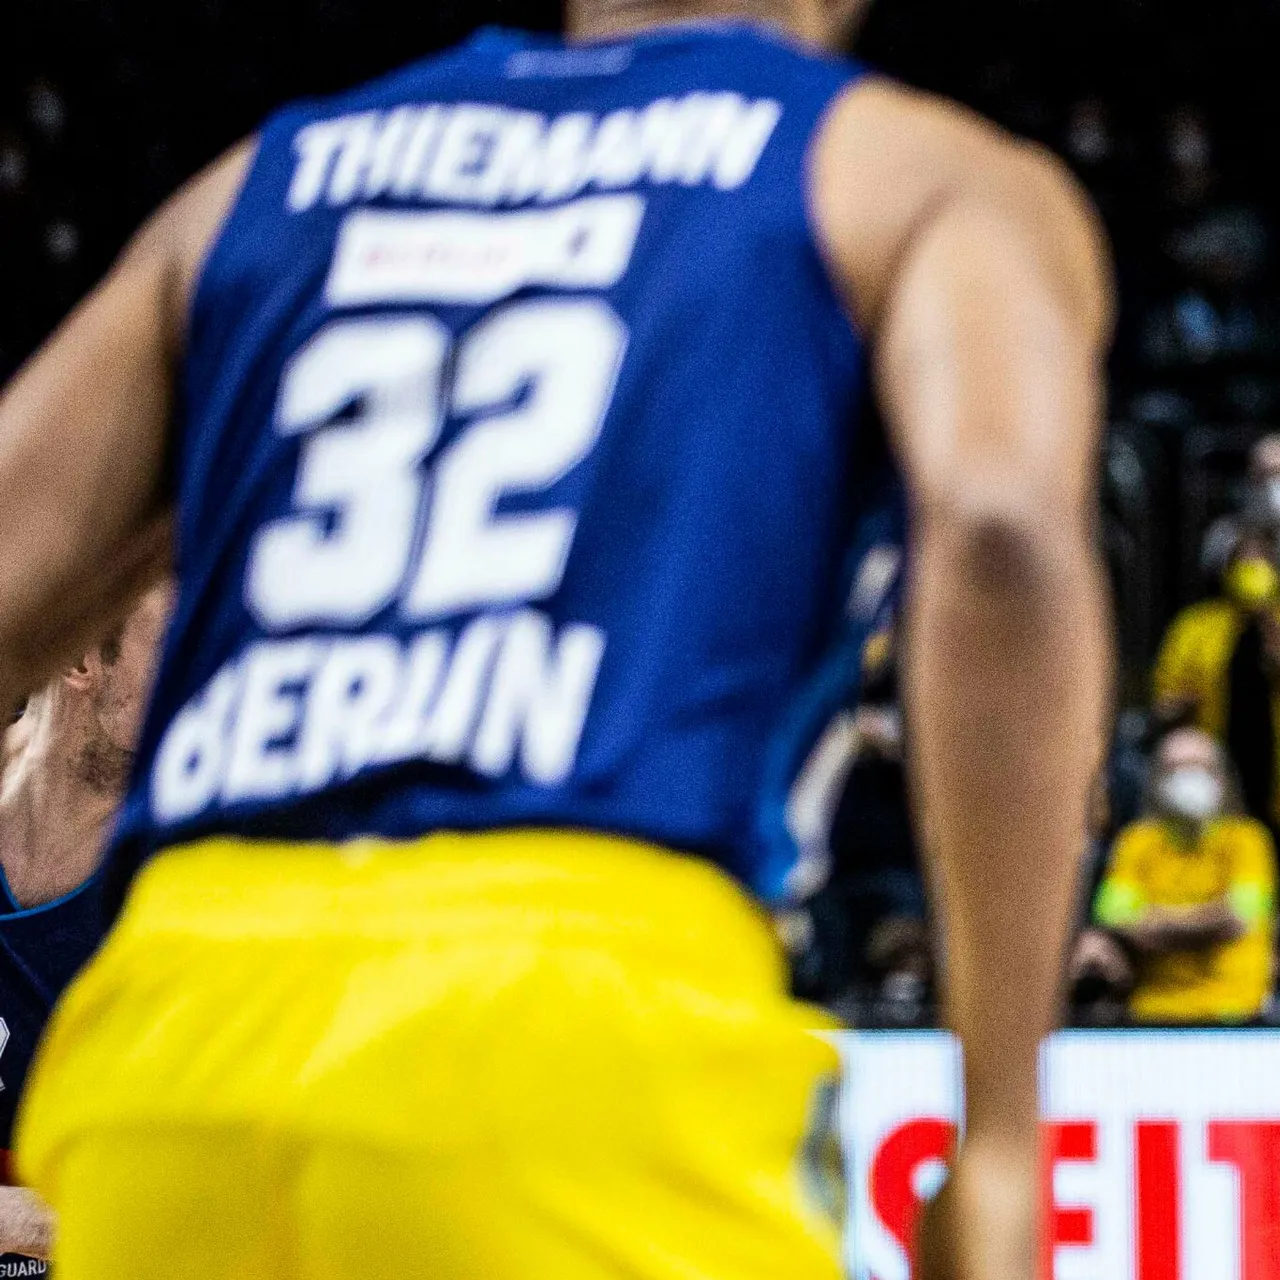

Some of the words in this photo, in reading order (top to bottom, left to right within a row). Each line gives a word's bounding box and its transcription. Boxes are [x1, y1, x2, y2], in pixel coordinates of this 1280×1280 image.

[287, 92, 783, 212] THIEMANN
[246, 296, 630, 632] 32
[150, 612, 605, 824] BERLIN
